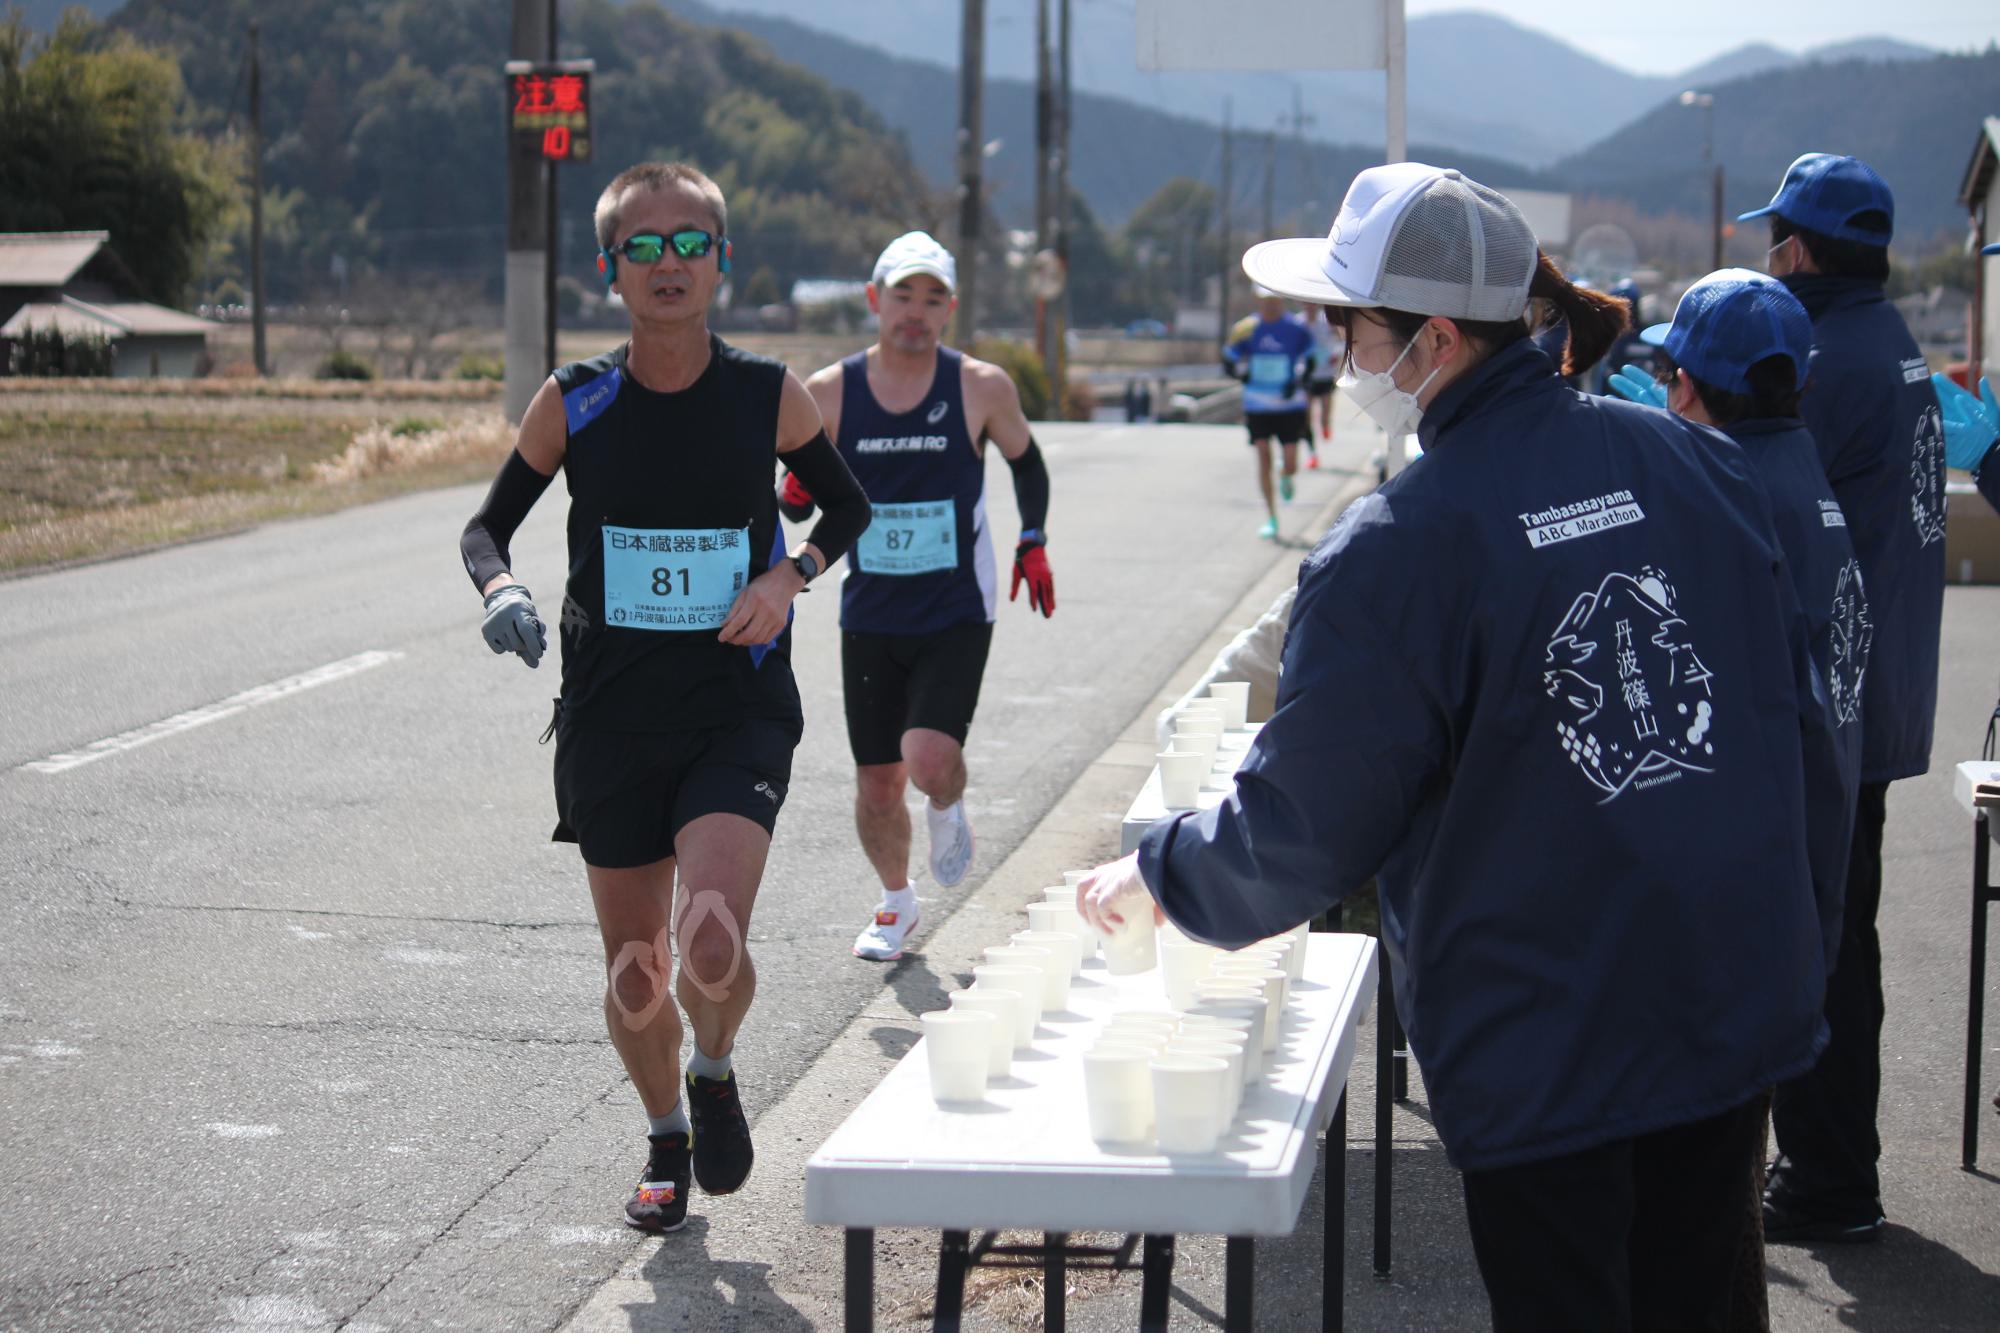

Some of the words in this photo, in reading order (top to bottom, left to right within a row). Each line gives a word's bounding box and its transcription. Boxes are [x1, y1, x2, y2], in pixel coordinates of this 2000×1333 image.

[514, 73, 585, 113] 注意
[544, 125, 571, 159] 10
[1518, 489, 1634, 527] Tambasasayama
[612, 531, 740, 553] 日本臓器製薬
[886, 529, 914, 550] 87
[1538, 524, 1572, 543] ABC
[1576, 508, 1639, 533] Marathon
[651, 566, 690, 597] 81
[1614, 617, 1659, 741] 丹波篠山
[1633, 769, 1683, 792] Tambasasayama
